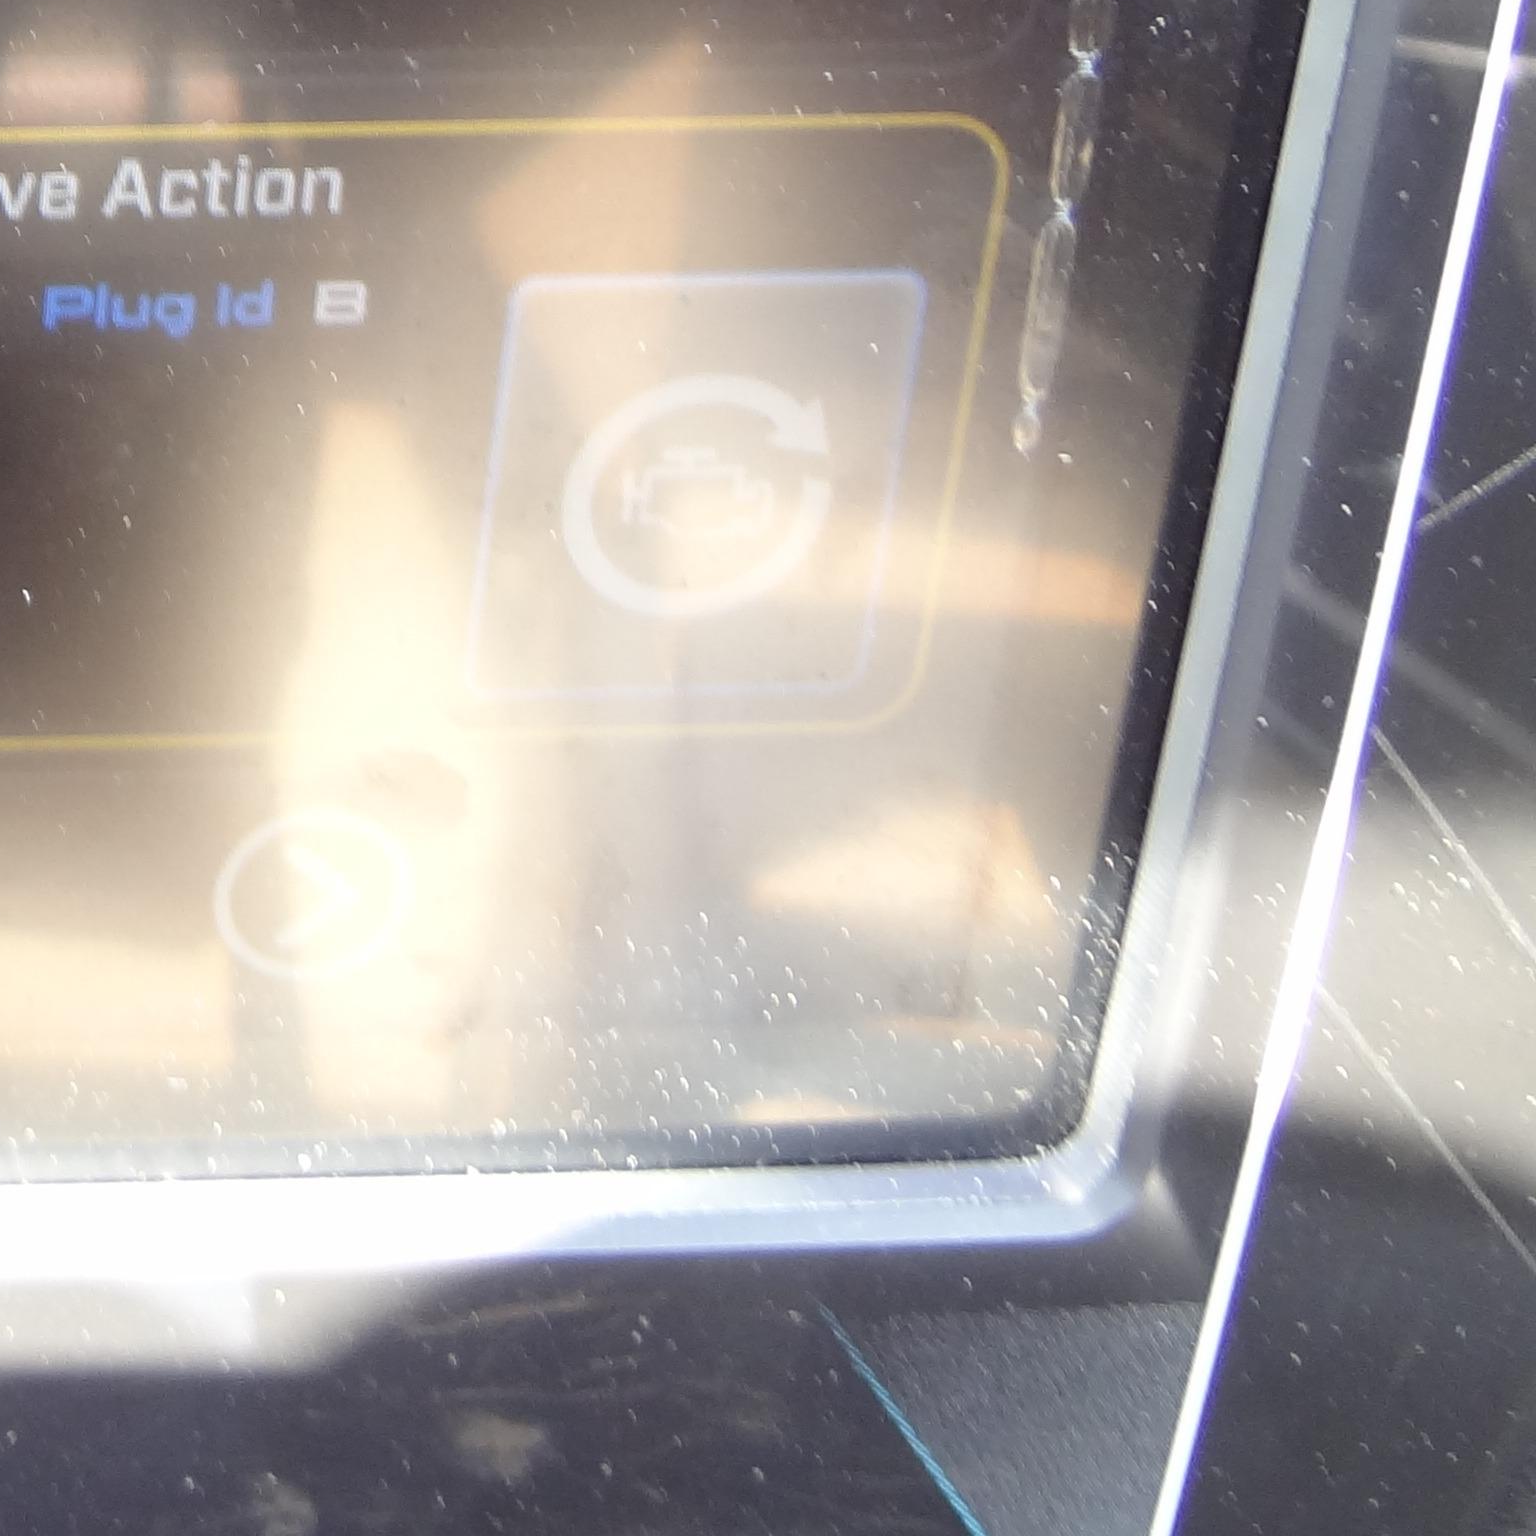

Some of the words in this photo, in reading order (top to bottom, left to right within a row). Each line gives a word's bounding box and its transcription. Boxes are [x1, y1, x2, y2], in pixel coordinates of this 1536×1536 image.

[102, 155, 344, 221] Action
[41, 282, 196, 338] Plug
[216, 280, 275, 328] Id
